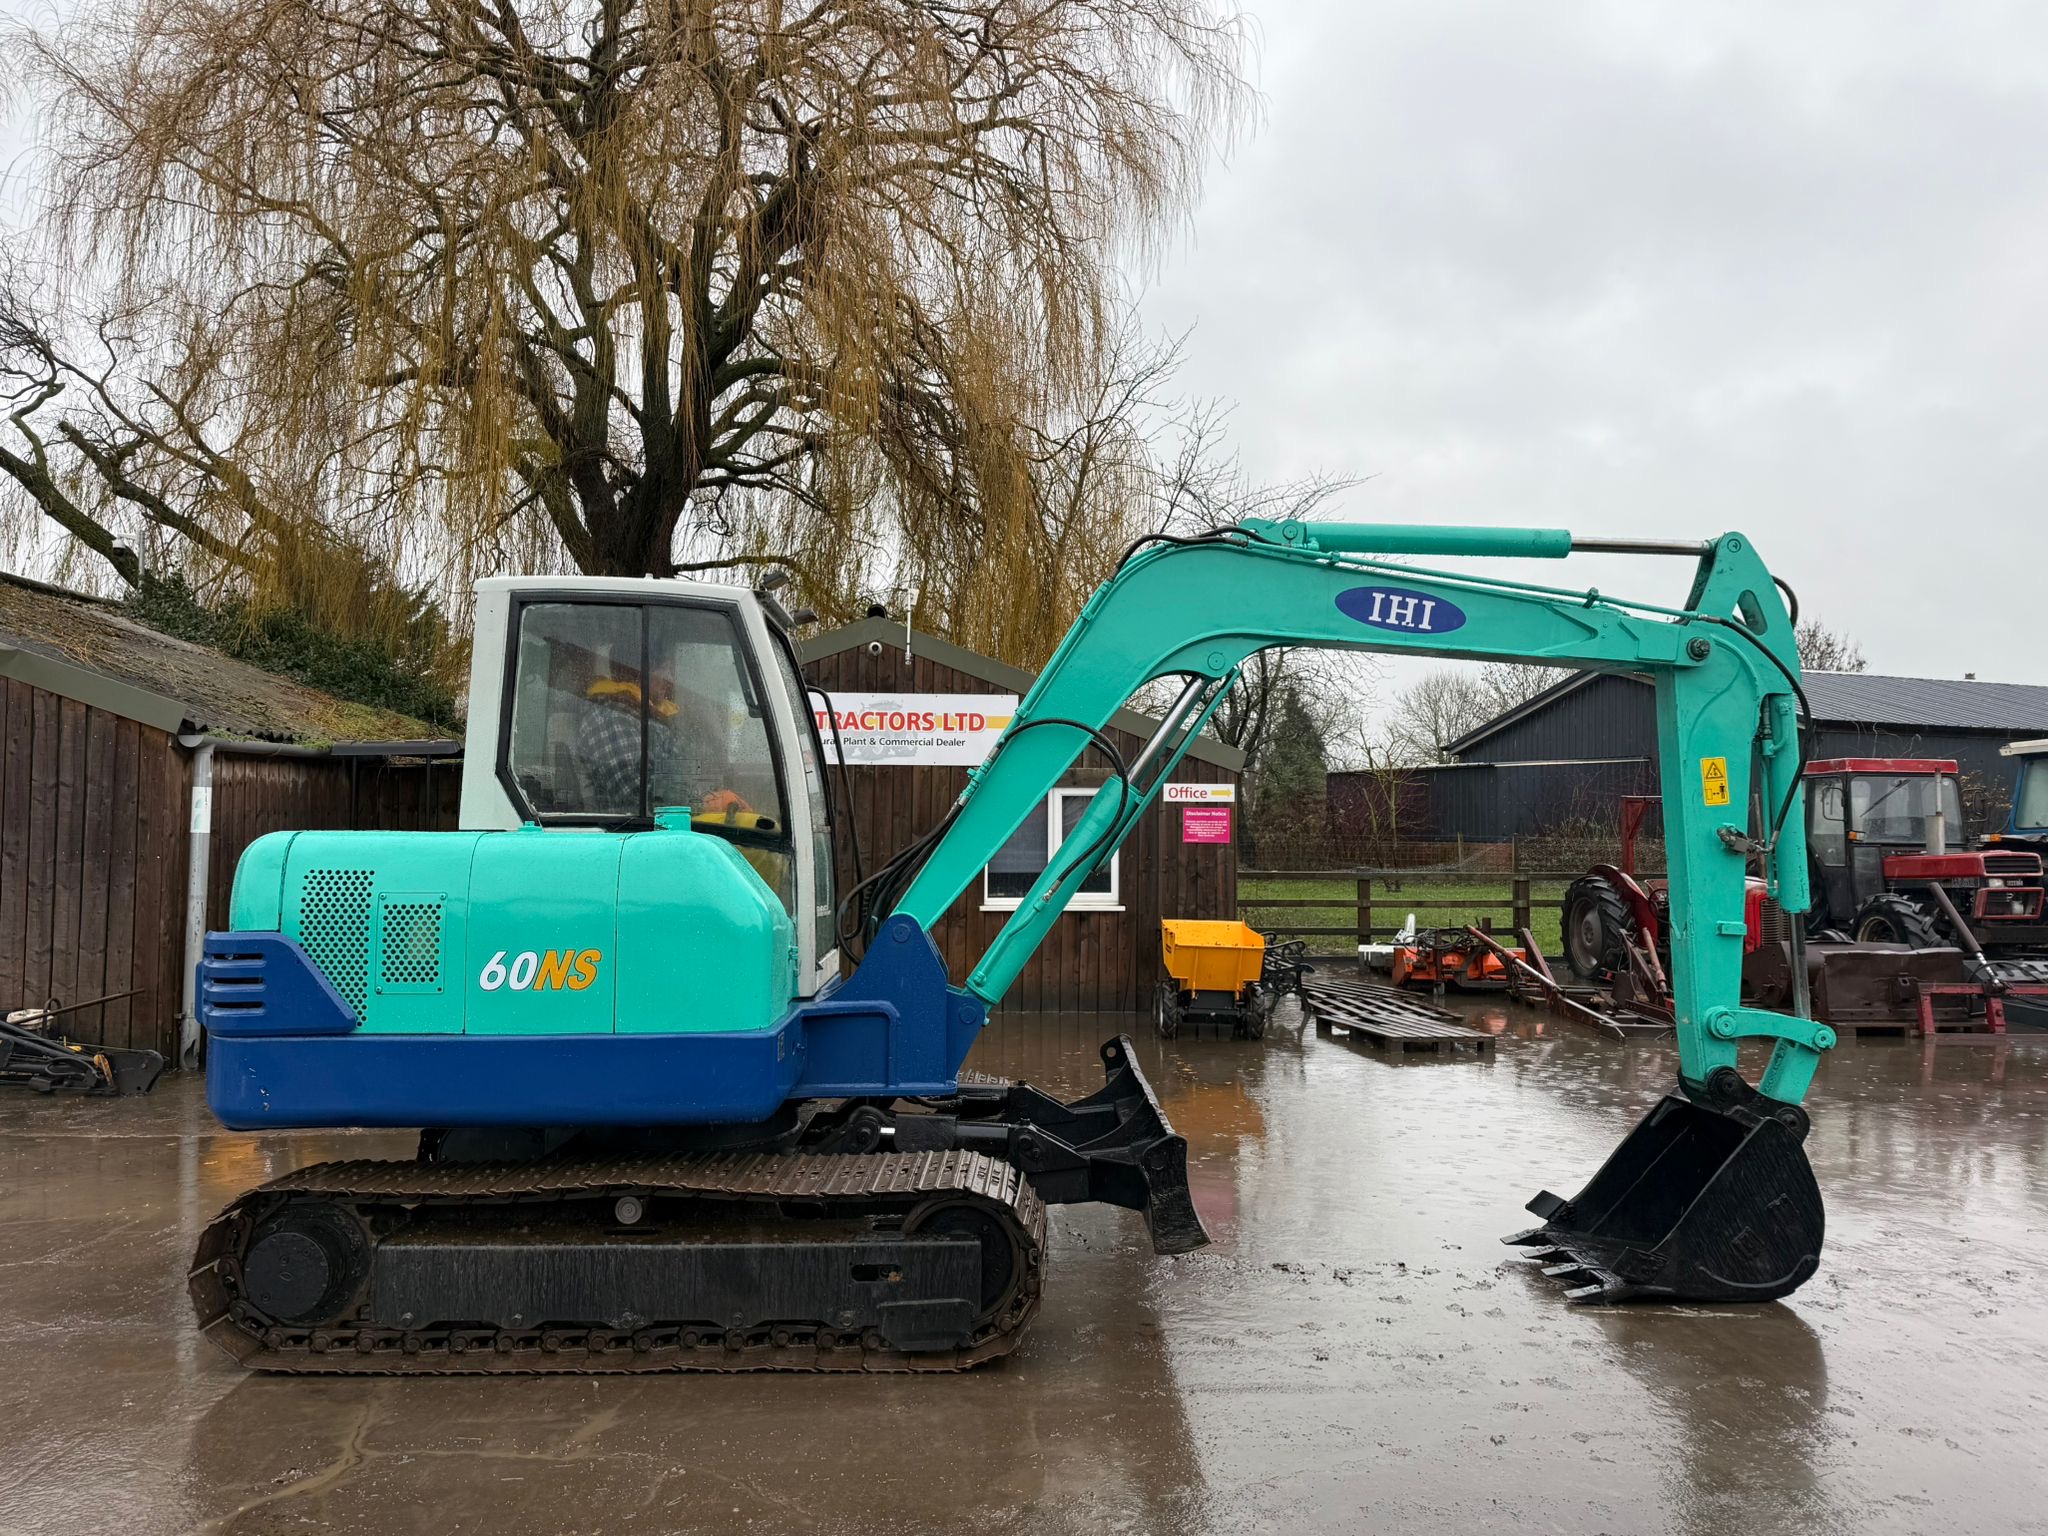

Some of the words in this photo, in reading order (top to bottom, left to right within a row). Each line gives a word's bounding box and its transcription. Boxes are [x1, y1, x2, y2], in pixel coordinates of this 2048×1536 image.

[1368, 592, 1435, 630] IHI
[815, 711, 937, 731] TRACTORS
[943, 713, 985, 732] LTD
[843, 738, 867, 746] Plant
[869, 738, 877, 746] &
[879, 738, 934, 747] Commercial
[936, 739, 966, 747] Dealer
[1168, 787, 1208, 799] Office
[479, 948, 602, 991] 60NS
